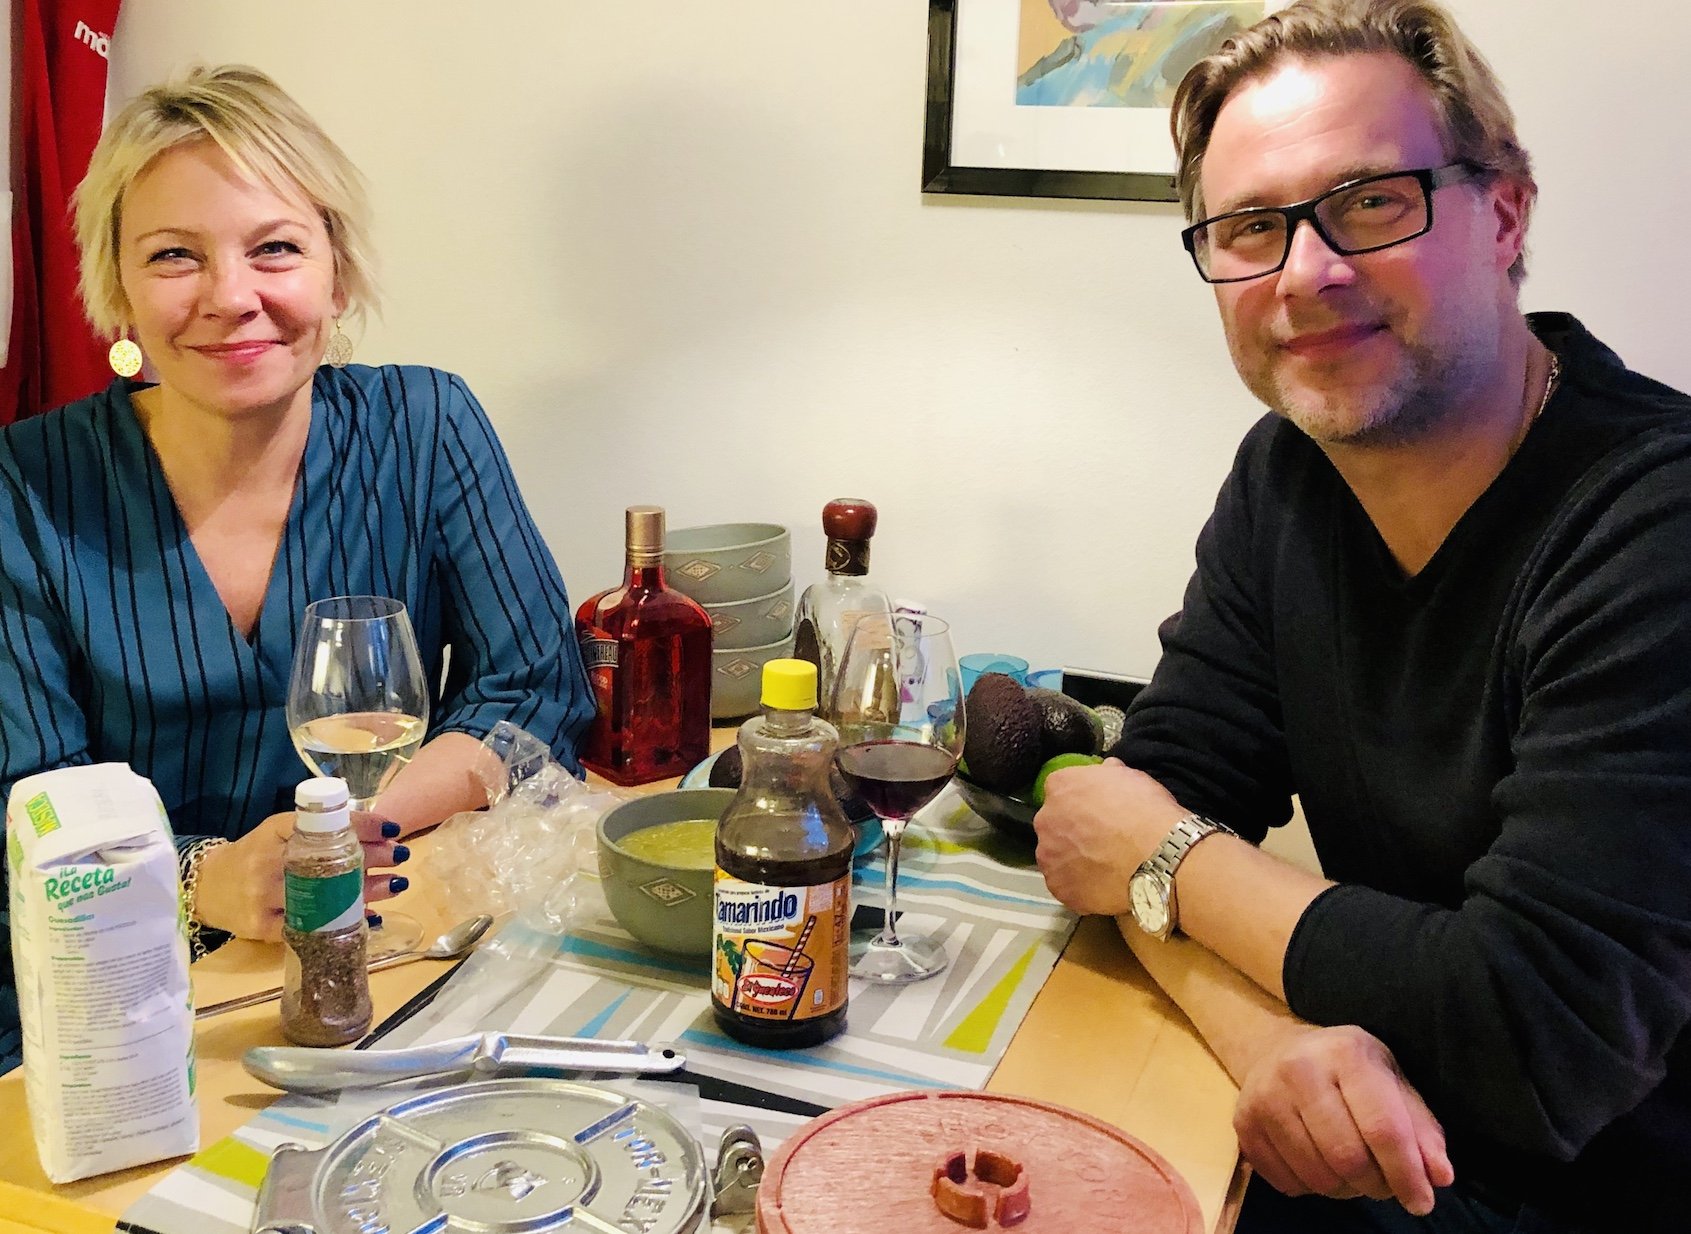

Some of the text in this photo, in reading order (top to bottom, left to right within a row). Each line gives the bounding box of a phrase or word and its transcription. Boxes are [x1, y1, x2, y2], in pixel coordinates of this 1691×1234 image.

[44, 868, 115, 902] Receta
[57, 897, 75, 912] que
[76, 891, 95, 903] nos
[716, 890, 798, 924] Tamarindo
